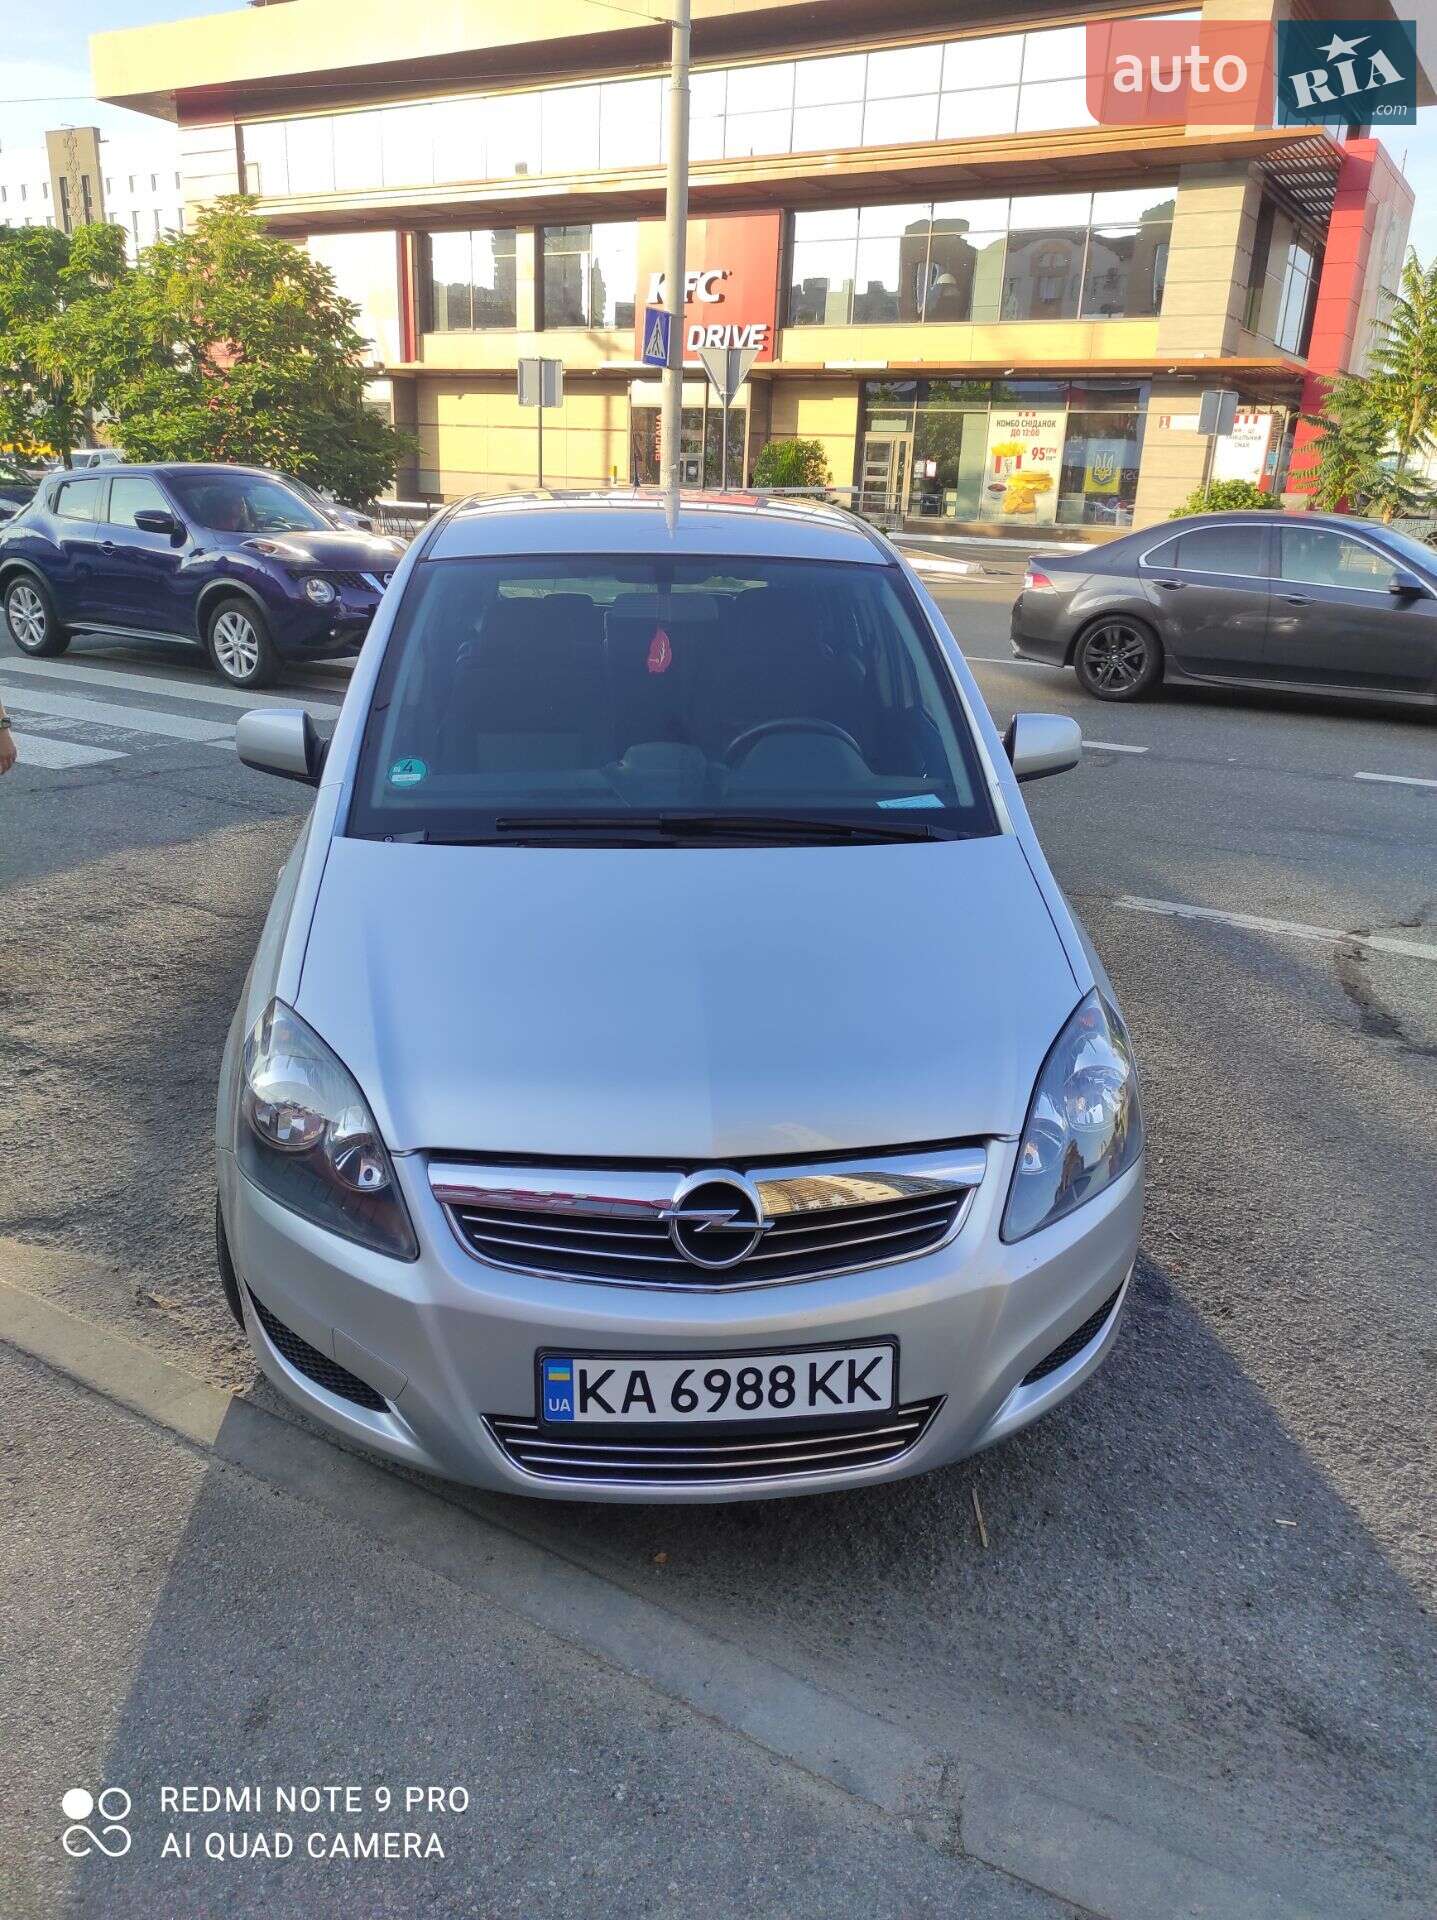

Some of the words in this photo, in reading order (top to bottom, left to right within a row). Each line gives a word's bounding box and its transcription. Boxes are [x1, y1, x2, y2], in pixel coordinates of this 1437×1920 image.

[646, 269, 726, 304] KFC
[687, 324, 768, 351] DRIVE
[996, 419, 1020, 428] КОМБО
[1032, 447, 1046, 461] 95
[578, 1368, 657, 1414] KA
[670, 1364, 796, 1414] 6988
[808, 1356, 884, 1407] KK
[548, 1398, 571, 1412] UA
